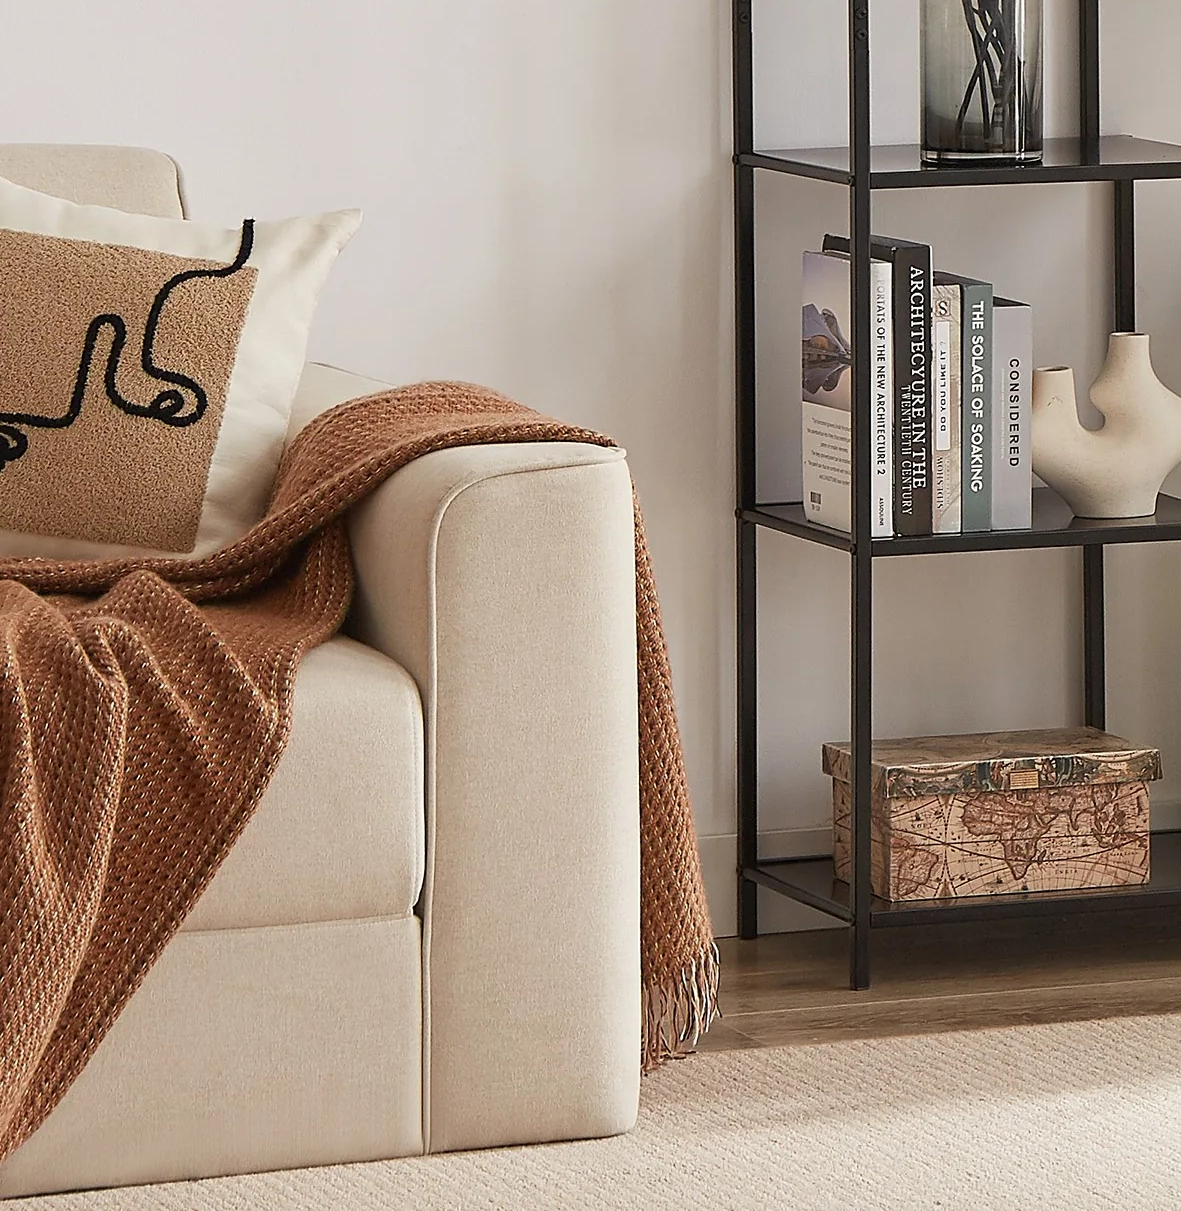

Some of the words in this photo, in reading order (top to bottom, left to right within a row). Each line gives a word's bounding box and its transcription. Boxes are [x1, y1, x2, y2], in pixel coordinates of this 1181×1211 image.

[876, 279, 886, 324] PORTATS
[972, 300, 984, 330] THE
[876, 327, 885, 341] OF
[876, 344, 885, 362] THE
[940, 350, 946, 360] IT
[971, 335, 984, 392] SOLACE
[876, 365, 885, 390] NEW
[900, 384, 912, 456] TWENTIETH
[940, 416, 946, 431] DO
[971, 398, 983, 418] OF
[1009, 358, 1020, 467] CONSIDERED
[876, 393, 886, 465] ARCHITECTURE
[911, 423, 925, 442] IN
[912, 447, 926, 488] THE
[971, 423, 983, 493] SOAKING
[901, 460, 912, 515] CENTURY
[936, 455, 944, 509] SIDESHOW
